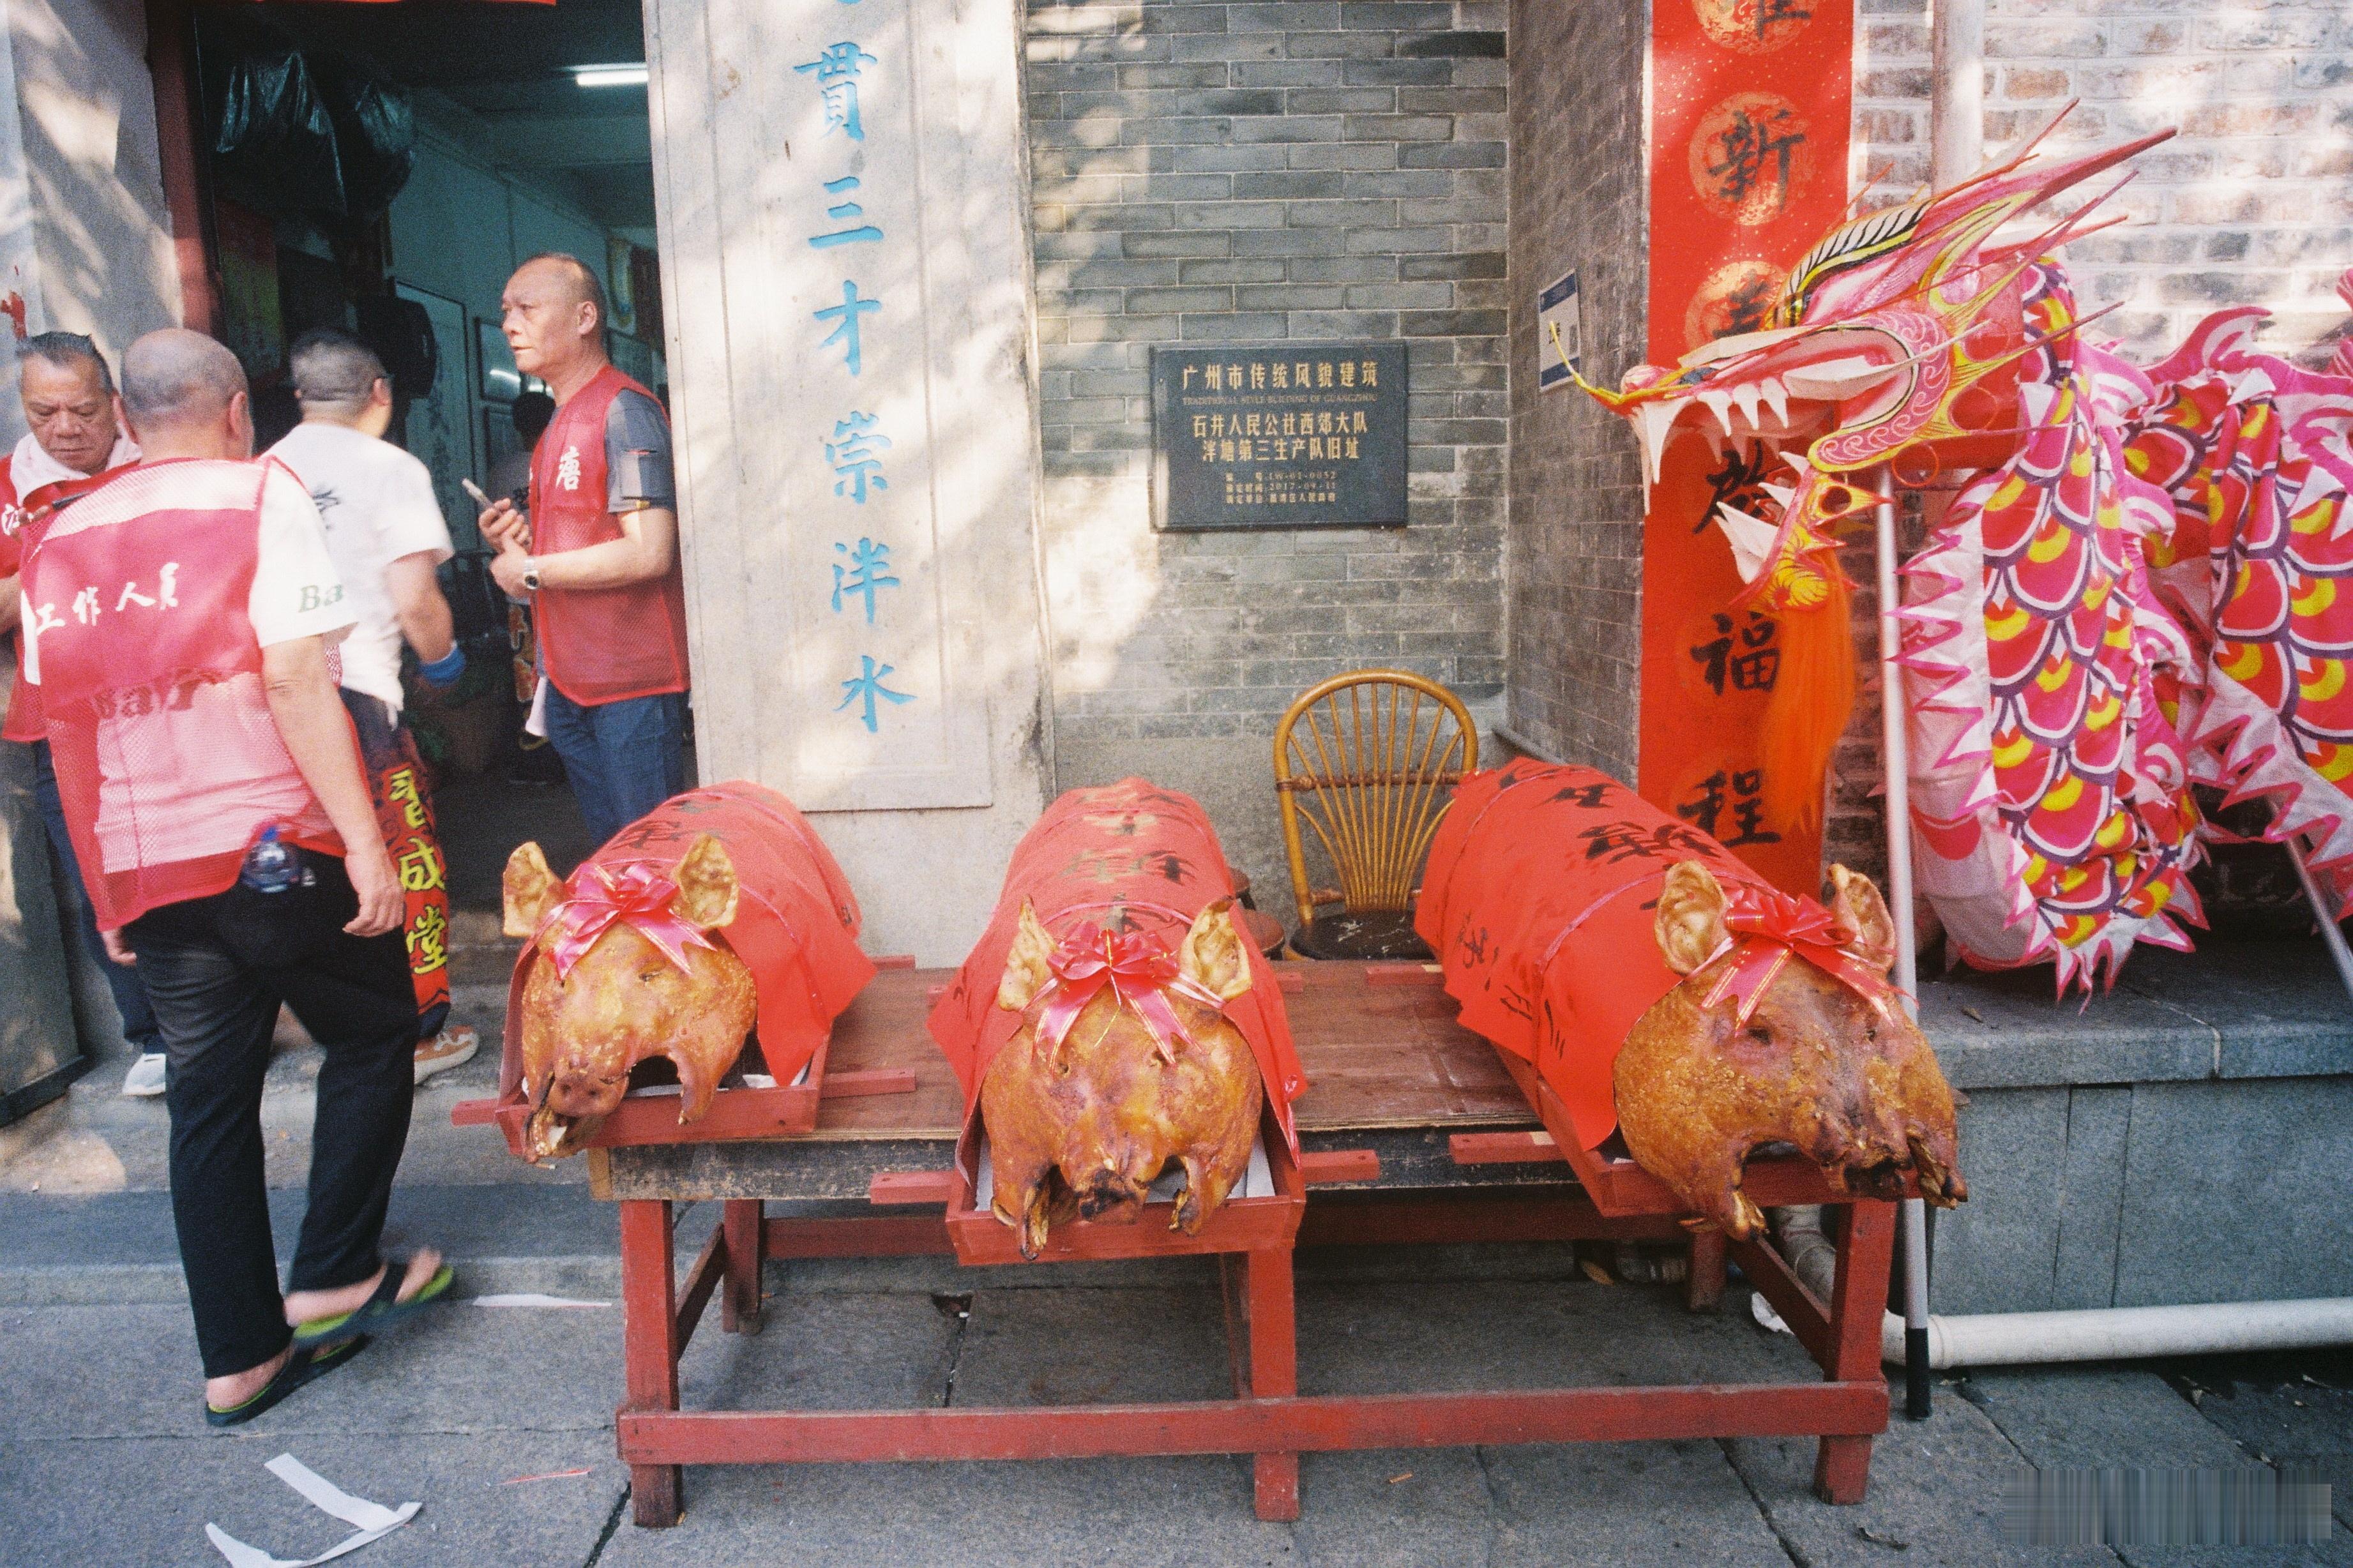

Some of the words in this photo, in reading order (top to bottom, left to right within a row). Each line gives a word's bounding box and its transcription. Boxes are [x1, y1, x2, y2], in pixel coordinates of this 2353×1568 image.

[793, 0, 918, 734] 貫三才崇泮水
[1182, 361, 1378, 390] 广州市传统风貌建筑
[1193, 411, 1368, 438] 石井人民公社西郊大队
[1202, 437, 1359, 462] 泮塘第三生产队旧址
